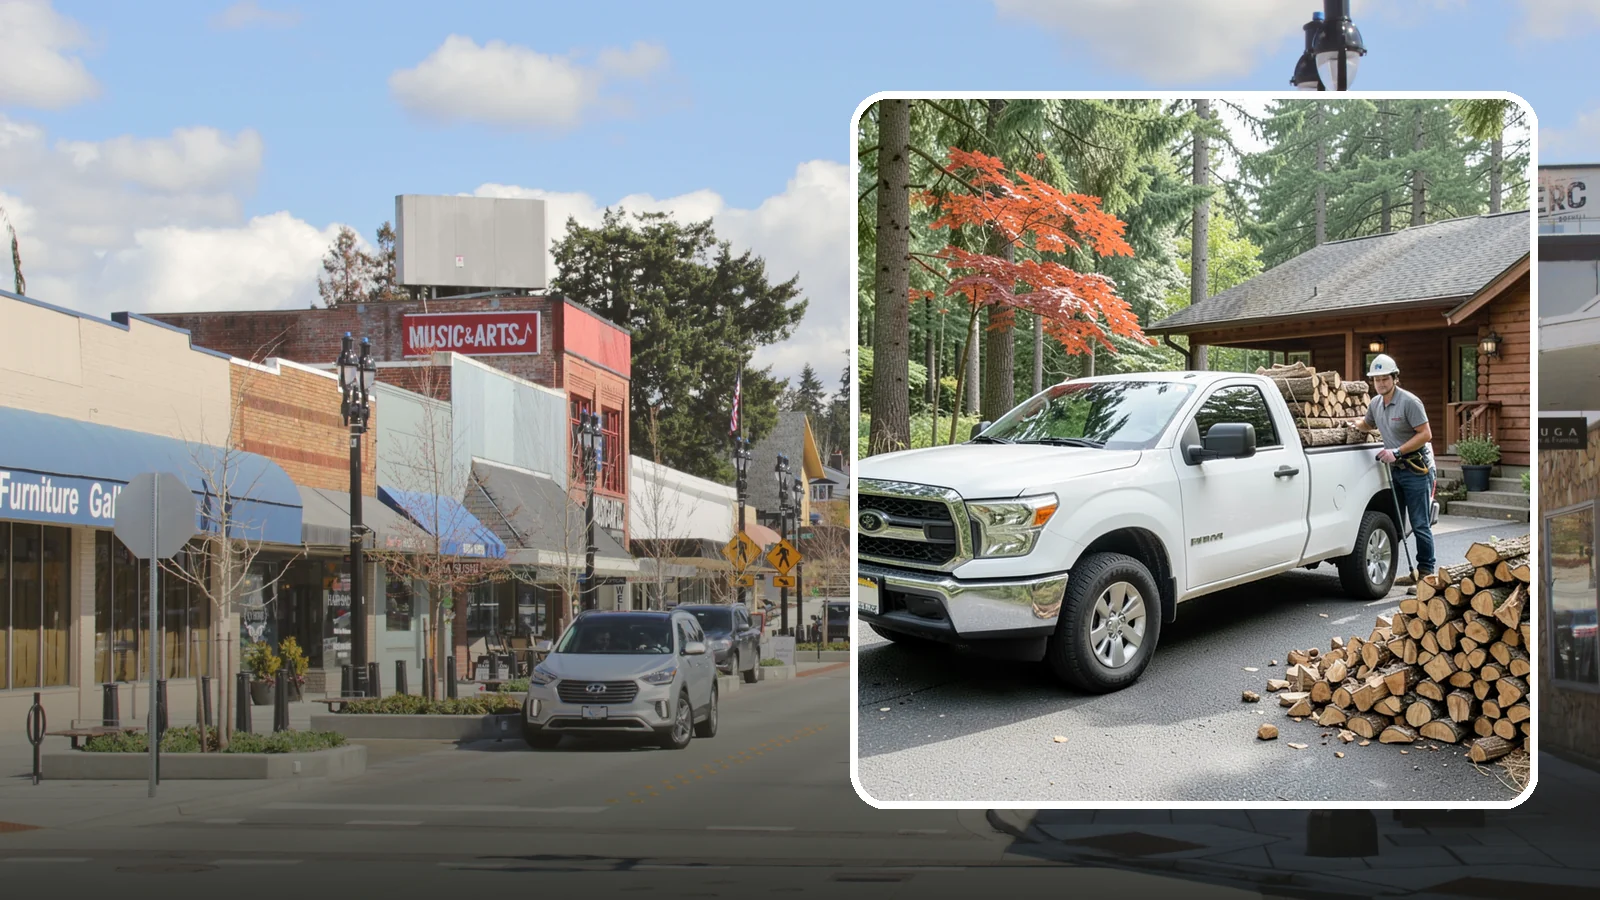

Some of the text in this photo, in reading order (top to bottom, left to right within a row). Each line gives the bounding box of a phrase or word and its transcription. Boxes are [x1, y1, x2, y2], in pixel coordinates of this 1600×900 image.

[1540, 427, 1577, 436] UGA
[0, 471, 122, 520] Furniture Gal
[453, 563, 479, 574] SUSHI
